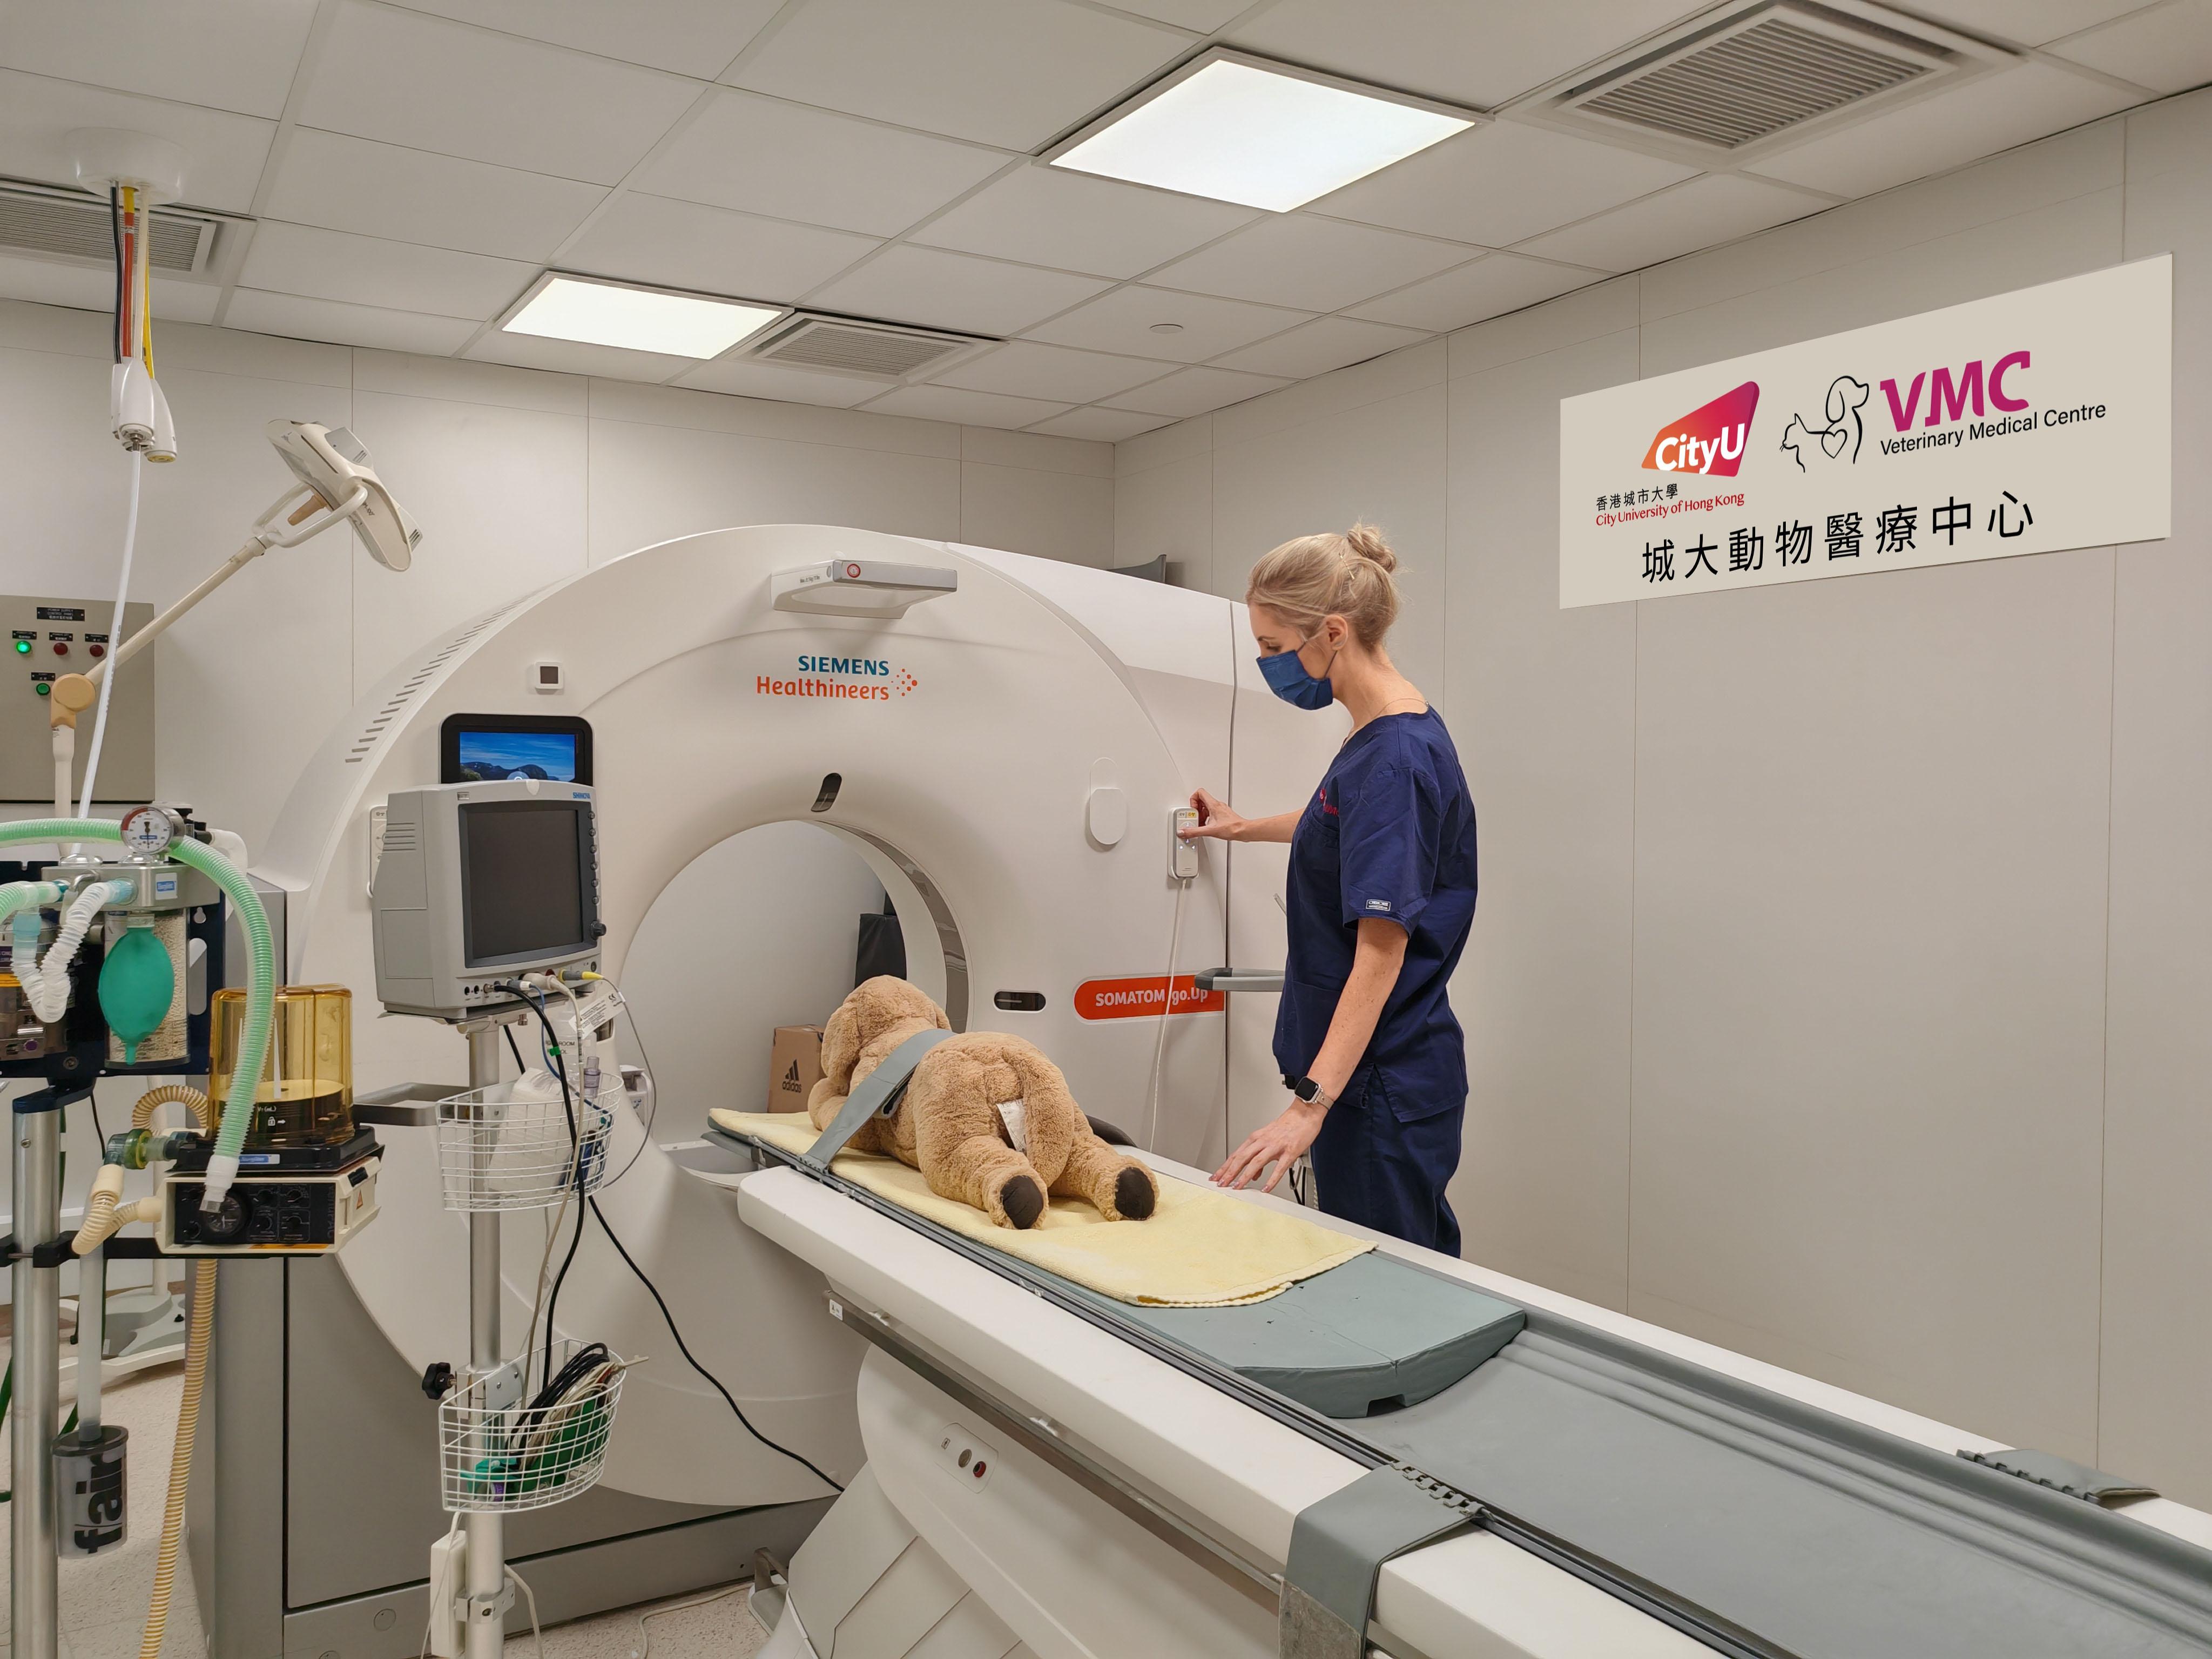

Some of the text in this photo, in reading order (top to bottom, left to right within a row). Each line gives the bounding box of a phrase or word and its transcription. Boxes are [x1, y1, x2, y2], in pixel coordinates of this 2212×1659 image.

[1880, 350, 2031, 432] VMC
[1880, 404, 2106, 456] Veterinary Medical Centre
[1655, 423, 1745, 475] CityU
[1596, 483, 1678, 511] 香港城市大學
[1596, 493, 1745, 527] City University of Hong Kong
[1642, 490, 2034, 583] 城大動物醫療中心
[798, 655, 889, 676] SIEMENS
[757, 676, 889, 700] Healthineers
[1095, 987, 1208, 1007] SOMATOM go.Up
[782, 1081, 802, 1093] adidas
